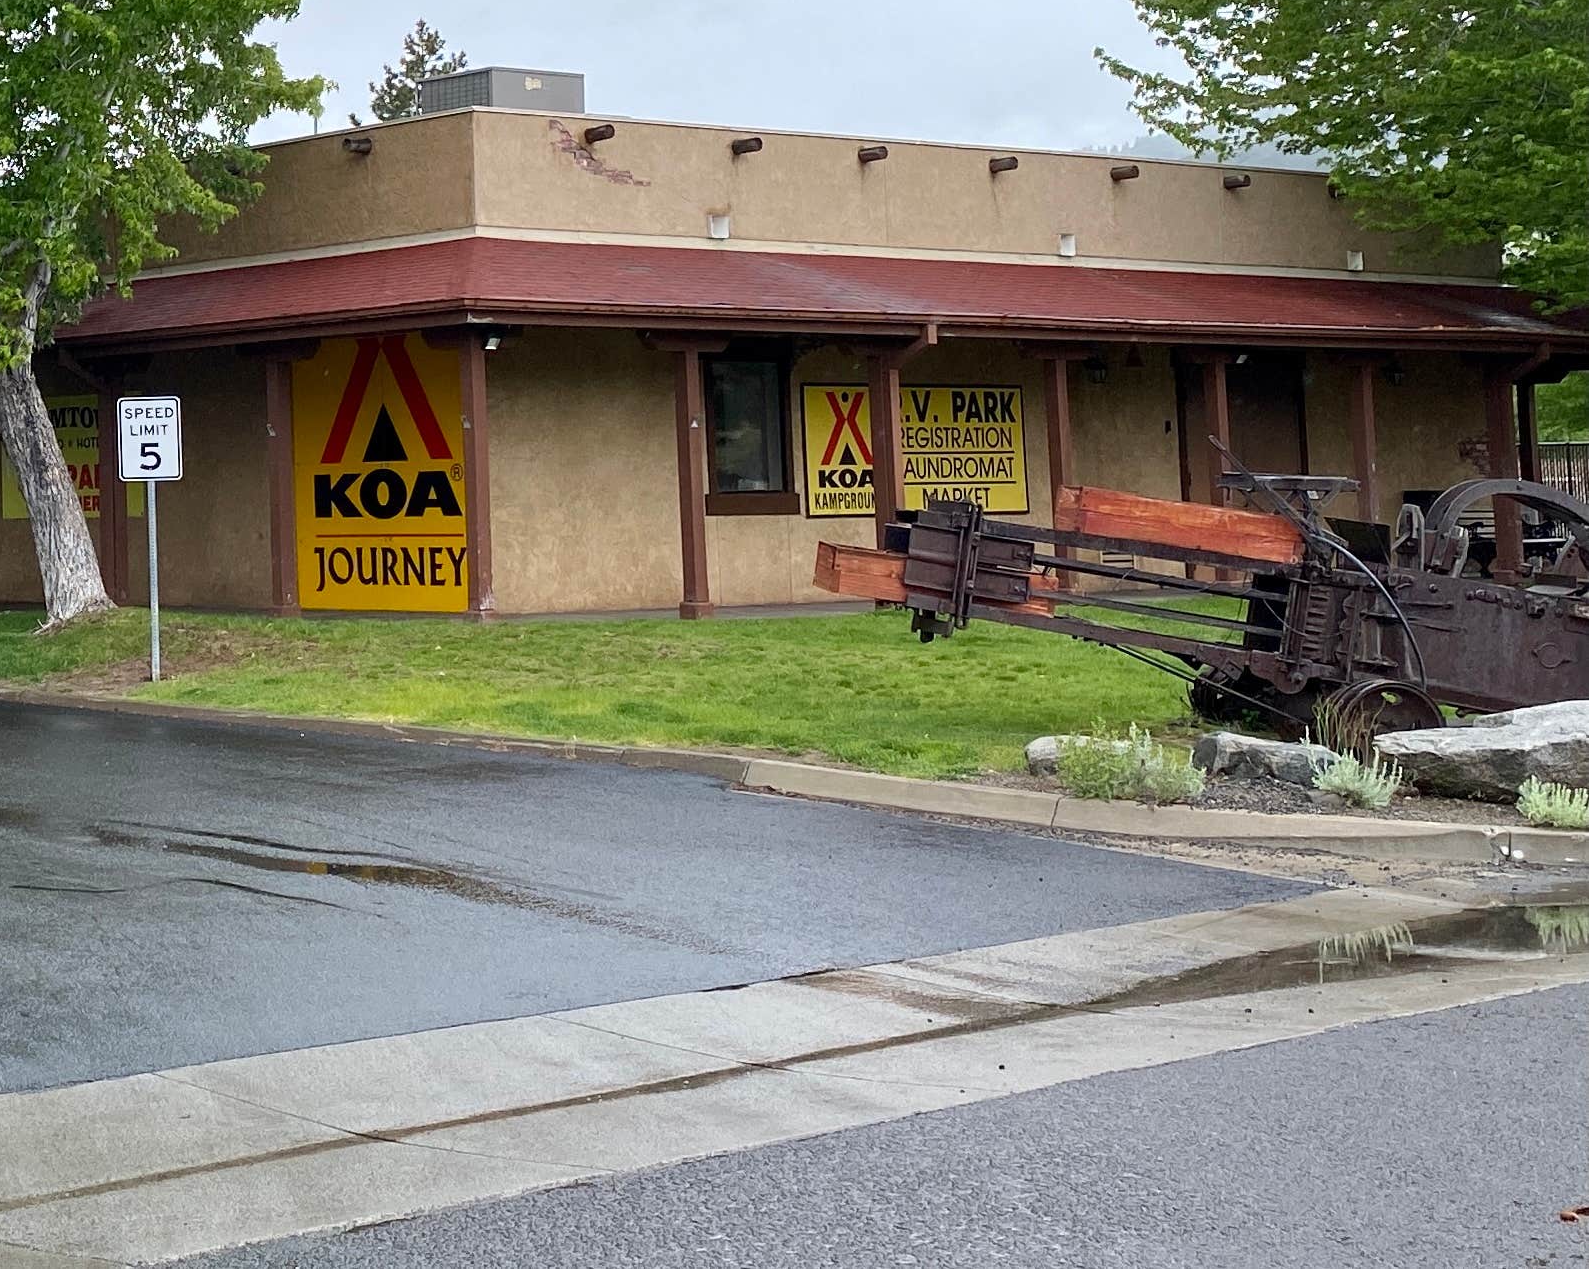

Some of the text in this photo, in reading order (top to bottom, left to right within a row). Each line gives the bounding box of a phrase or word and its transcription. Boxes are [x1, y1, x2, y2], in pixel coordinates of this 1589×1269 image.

[124, 407, 174, 419] SPEED
[951, 390, 1016, 423] PARK
[129, 424, 169, 437] LIMIT
[139, 442, 161, 471] 5
[818, 468, 874, 489] KOA
[313, 468, 463, 519] KOA
[313, 546, 467, 592] JOURNEY
